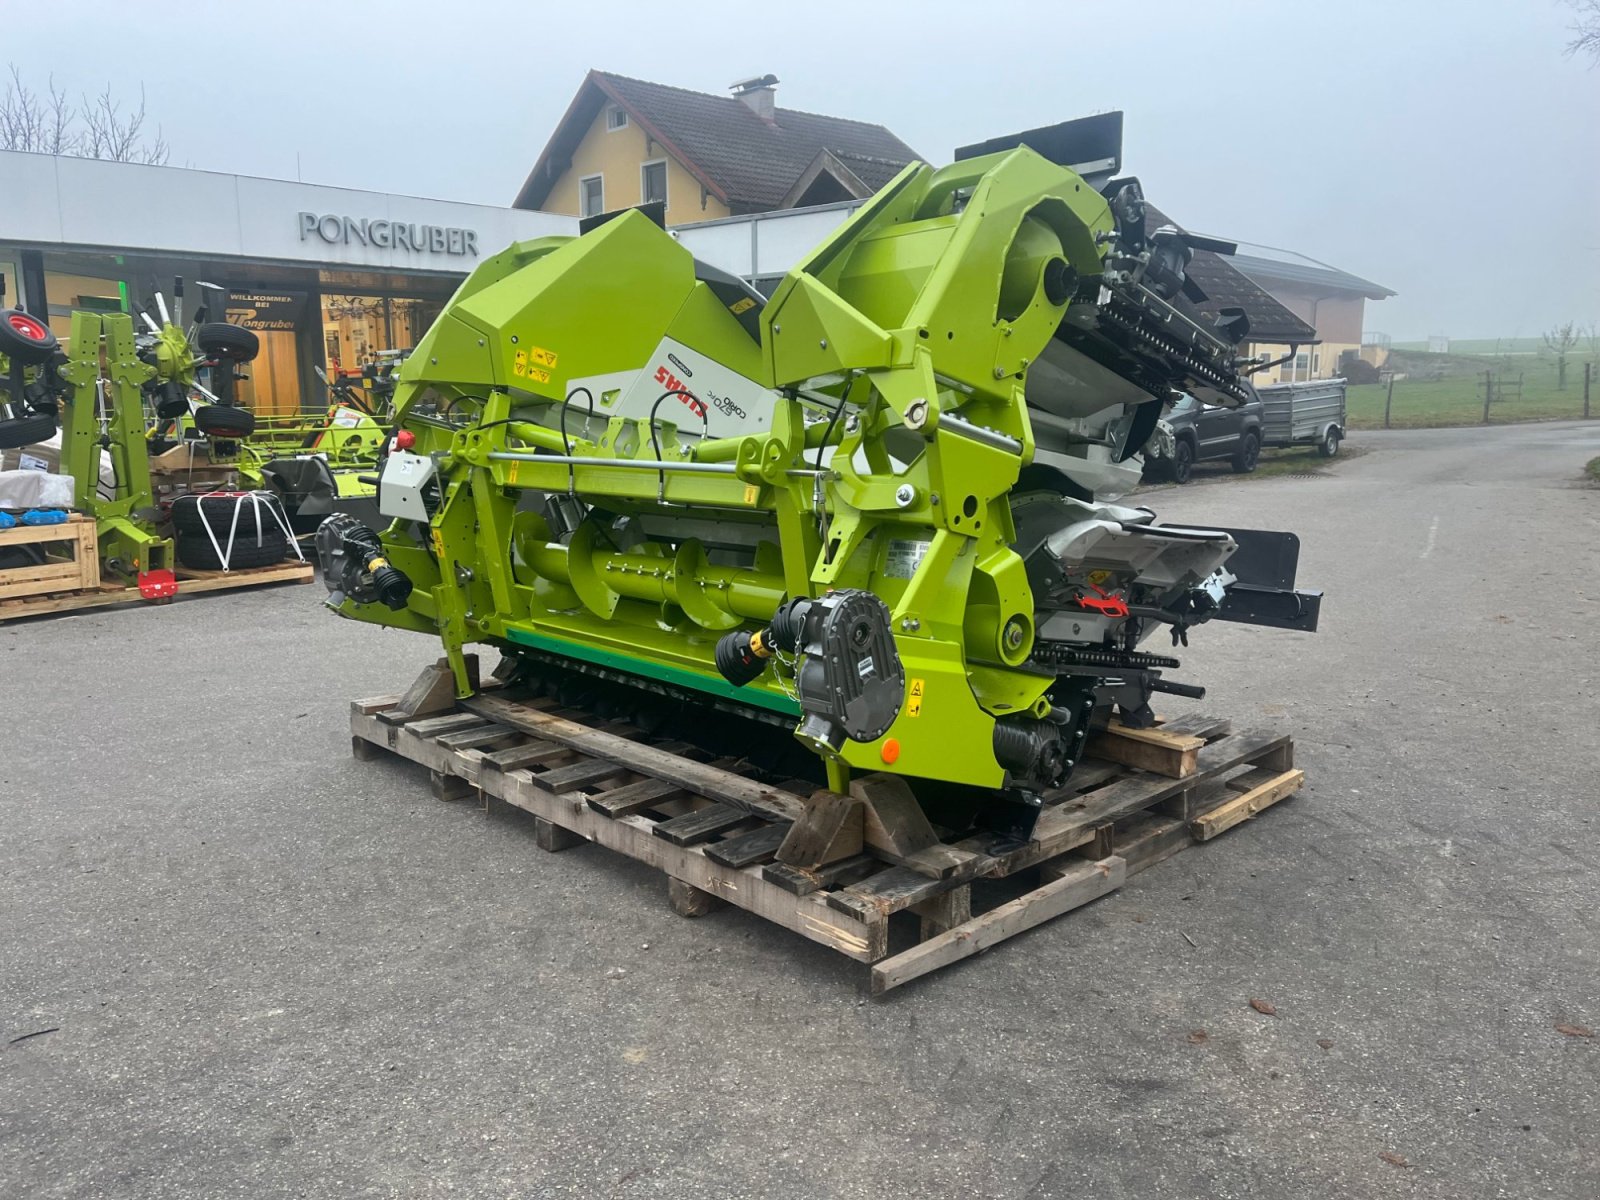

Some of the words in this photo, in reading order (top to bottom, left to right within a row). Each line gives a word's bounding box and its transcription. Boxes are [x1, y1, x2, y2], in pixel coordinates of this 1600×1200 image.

[298, 211, 479, 256] PONGRUBER
[654, 366, 709, 418] CLAAS
[723, 397, 747, 419] CORIO
